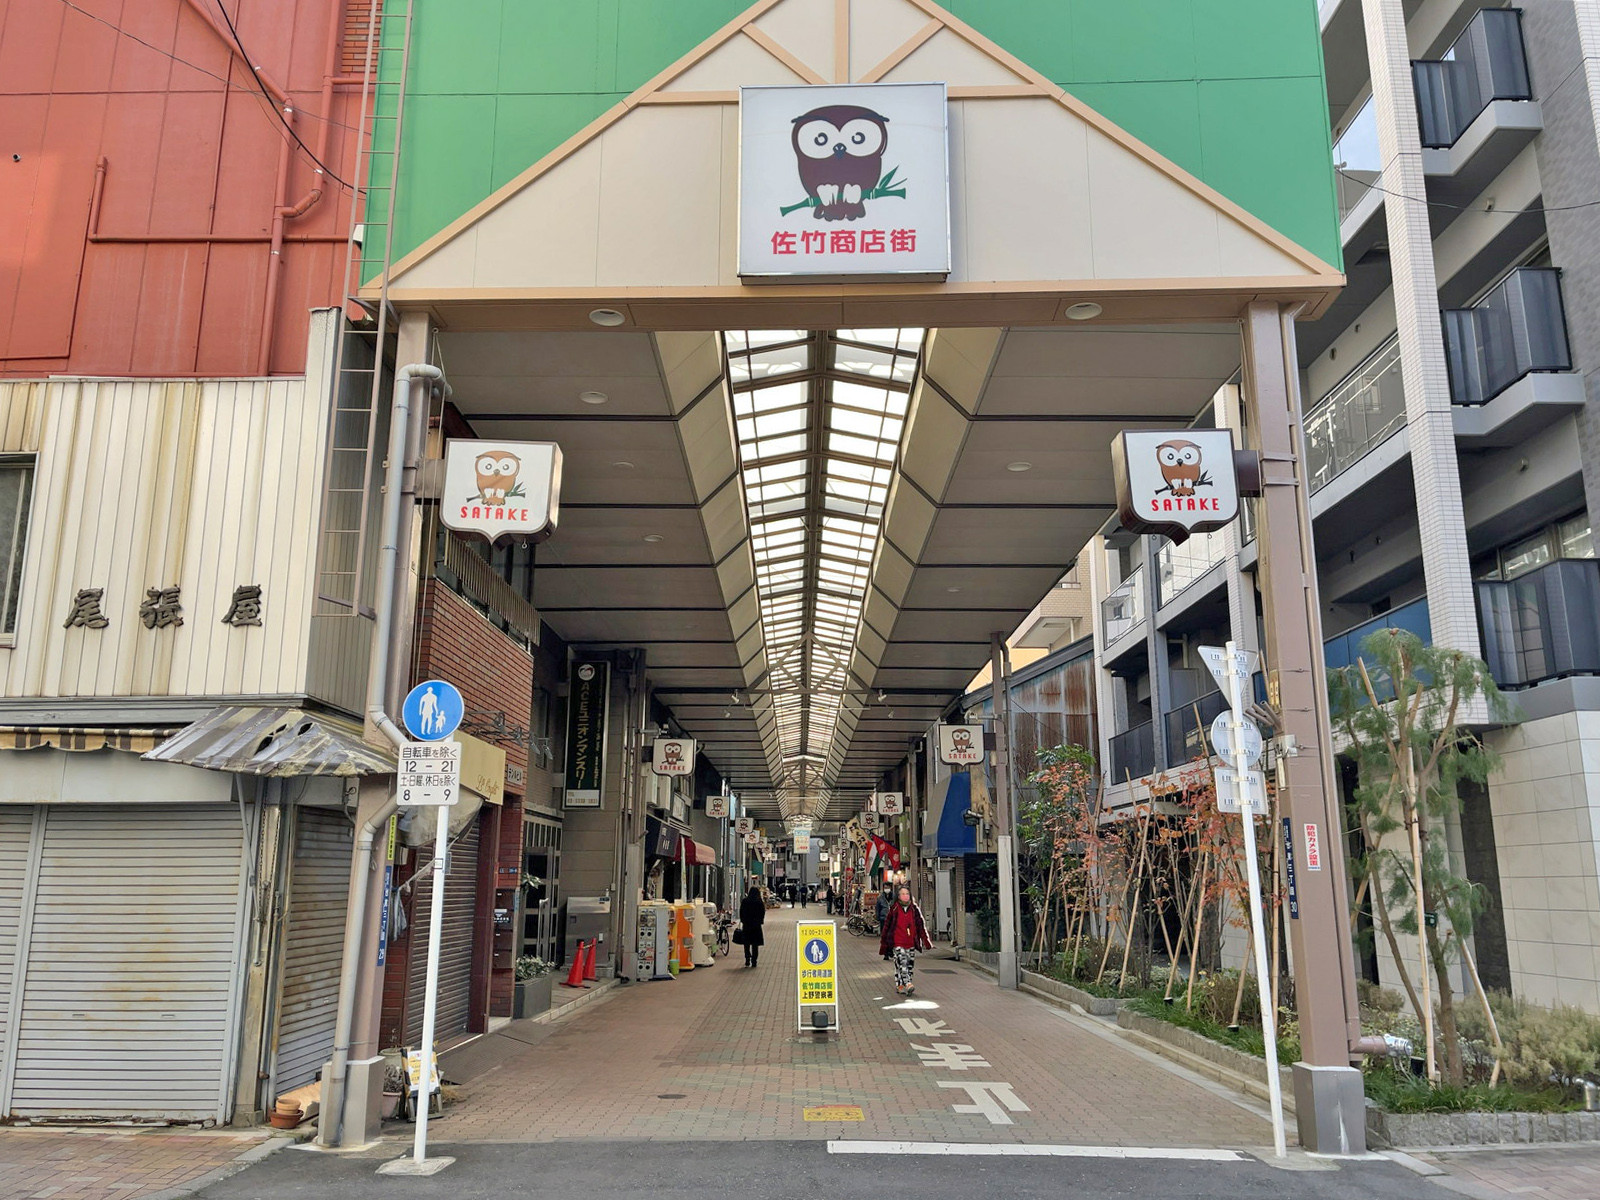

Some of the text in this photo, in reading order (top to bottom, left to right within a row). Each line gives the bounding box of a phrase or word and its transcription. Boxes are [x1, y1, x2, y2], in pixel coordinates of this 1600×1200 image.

[770, 228, 917, 255] 佐竹商店街
[1151, 497, 1220, 511] SATAKE
[460, 506, 529, 521] SATAKE
[63, 584, 262, 630] 尾張屋
[402, 747, 457, 758] 自転車を除く
[405, 760, 417, 773] 12
[441, 760, 453, 772] 21
[403, 789, 411, 801] 8
[443, 789, 451, 801] 9
[1306, 825, 1318, 866] 防犯カメラ設置
